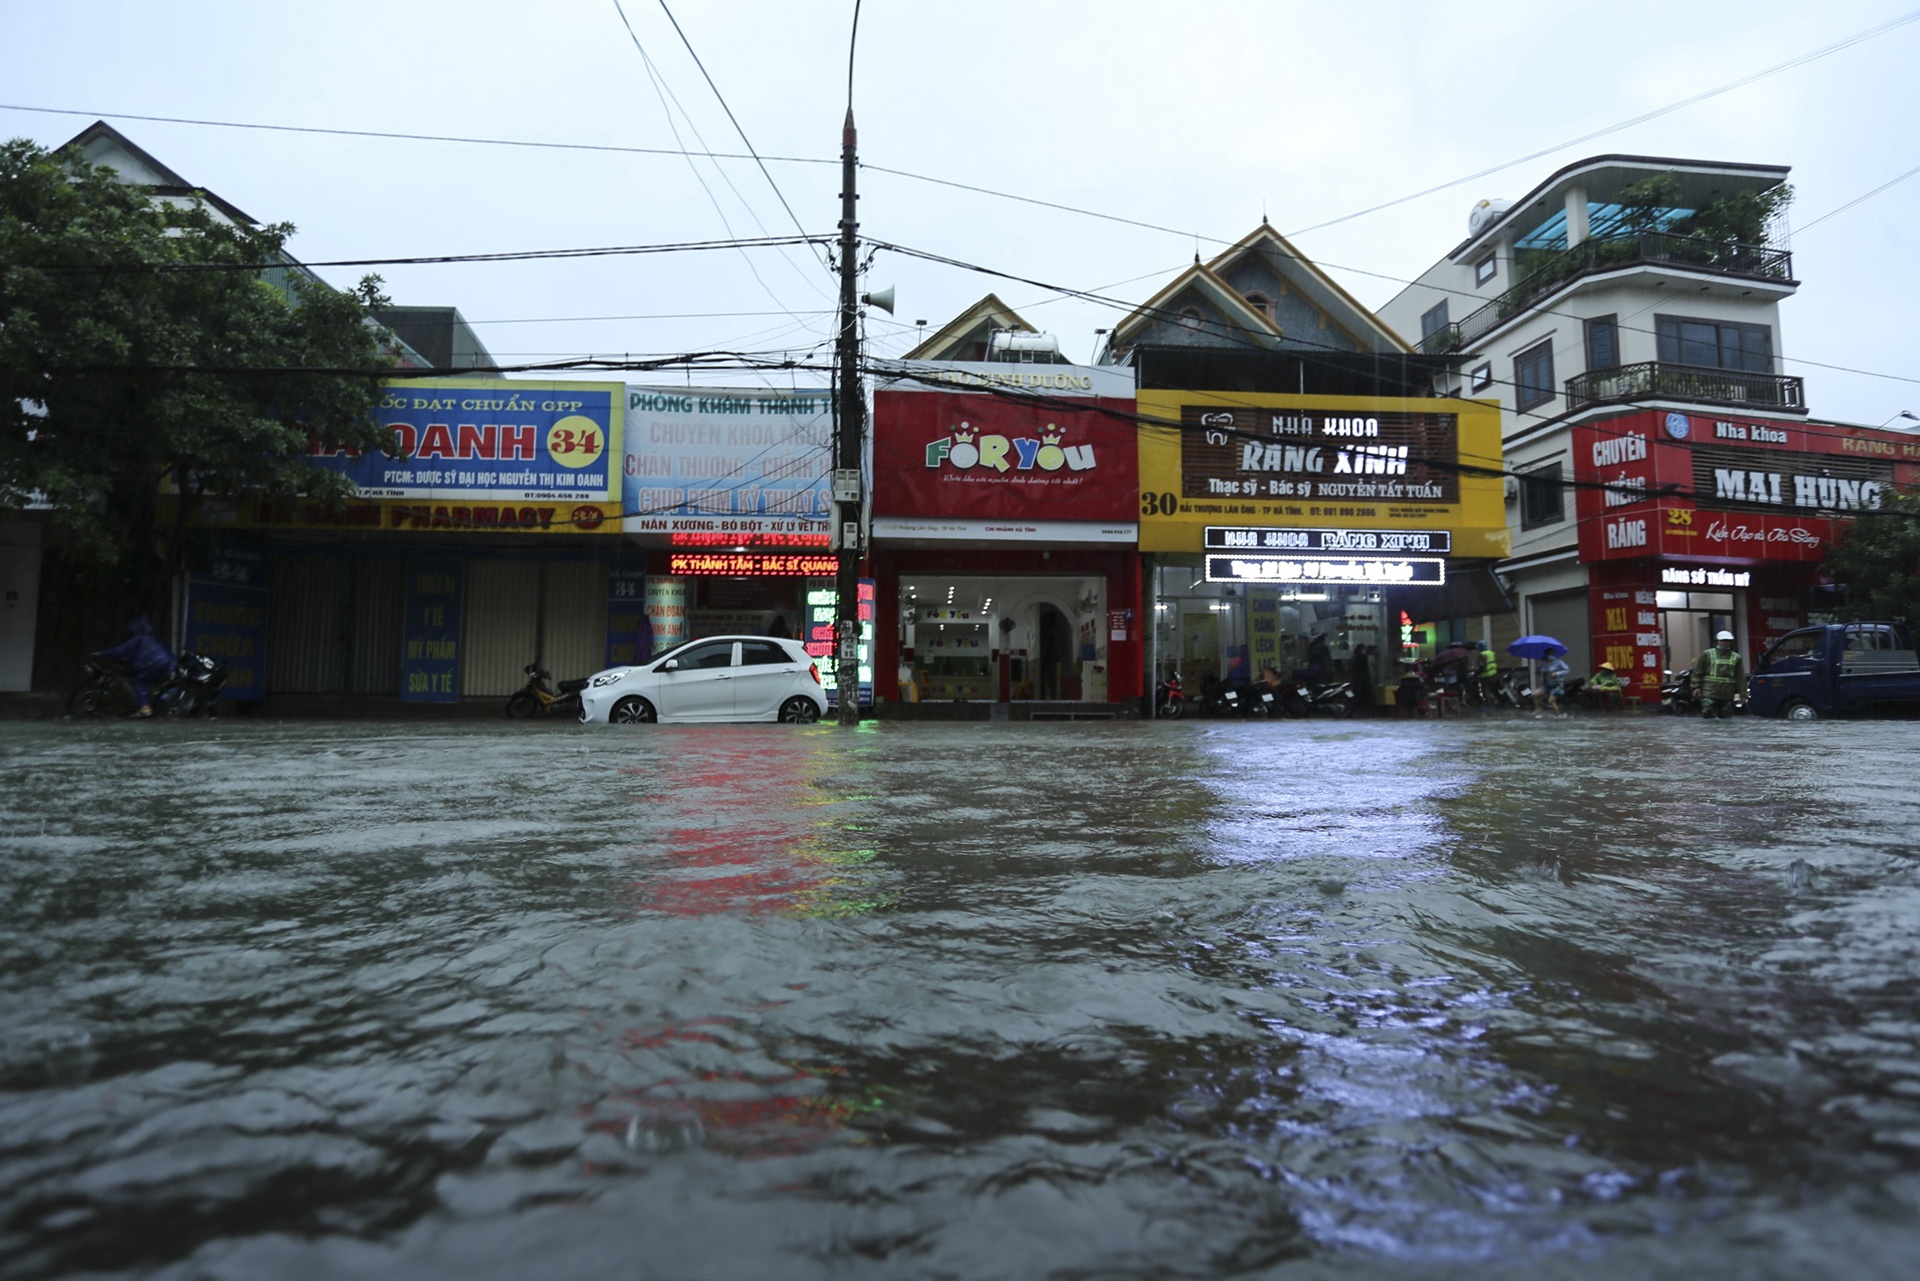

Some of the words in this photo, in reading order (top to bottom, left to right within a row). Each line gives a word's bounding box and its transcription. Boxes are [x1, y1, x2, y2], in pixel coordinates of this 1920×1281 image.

[413, 397, 457, 412] ĐẠT
[460, 393, 537, 411] CHUẨN
[541, 400, 583, 412] GPP
[630, 391, 693, 414] PHÒNG
[699, 395, 752, 415] KHÁM
[650, 419, 722, 446] CHUYÊN
[727, 424, 774, 446] KHOA
[1322, 417, 1378, 437] KHOA
[1716, 422, 1747, 440] Nha
[1750, 425, 1787, 443] khoa
[380, 422, 537, 460] OANH
[551, 429, 600, 454] 34
[1593, 430, 1647, 467] CHUYÊN
[624, 447, 672, 478] CHẤN
[677, 454, 744, 479] THƯƠNG
[1333, 444, 1409, 475] XINH
[384, 470, 414, 484] PTCM:
[416, 470, 442, 486] DƯỢC
[458, 471, 475, 487] ĐẠI
[477, 472, 497, 488] HỌC
[498, 468, 537, 486] NGUYỄN
[539, 473, 554, 489] THỊ
[556, 473, 575, 486] KIM
[576, 474, 604, 487] OANH
[1208, 478, 1240, 496] Thạc
[1243, 478, 1258, 496] sỹ
[1269, 479, 1294, 495] Bác
[1297, 481, 1311, 497] sỹ
[1318, 478, 1377, 497] NGUYỄN
[1378, 479, 1404, 497] TẤT
[1406, 480, 1443, 498] TUẤN
[1714, 468, 1783, 505] MAI
[639, 487, 685, 517] CHỤP
[687, 488, 733, 515] PHIM
[738, 484, 760, 514] KỸ
[763, 484, 816, 519] THUẬT
[1141, 492, 1178, 516] 30
[392, 505, 555, 530] PHARMACY
[672, 519, 714, 531] XƯƠNG
[740, 519, 763, 533] BỘT
[1668, 508, 1693, 526] 28
[1381, 533, 1430, 549] XINH
[1607, 517, 1647, 549] RĂNG
[673, 558, 688, 570] PK
[800, 561, 839, 573] QUANG
[1662, 568, 1690, 584] RĂNG
[615, 581, 637, 597] 34
